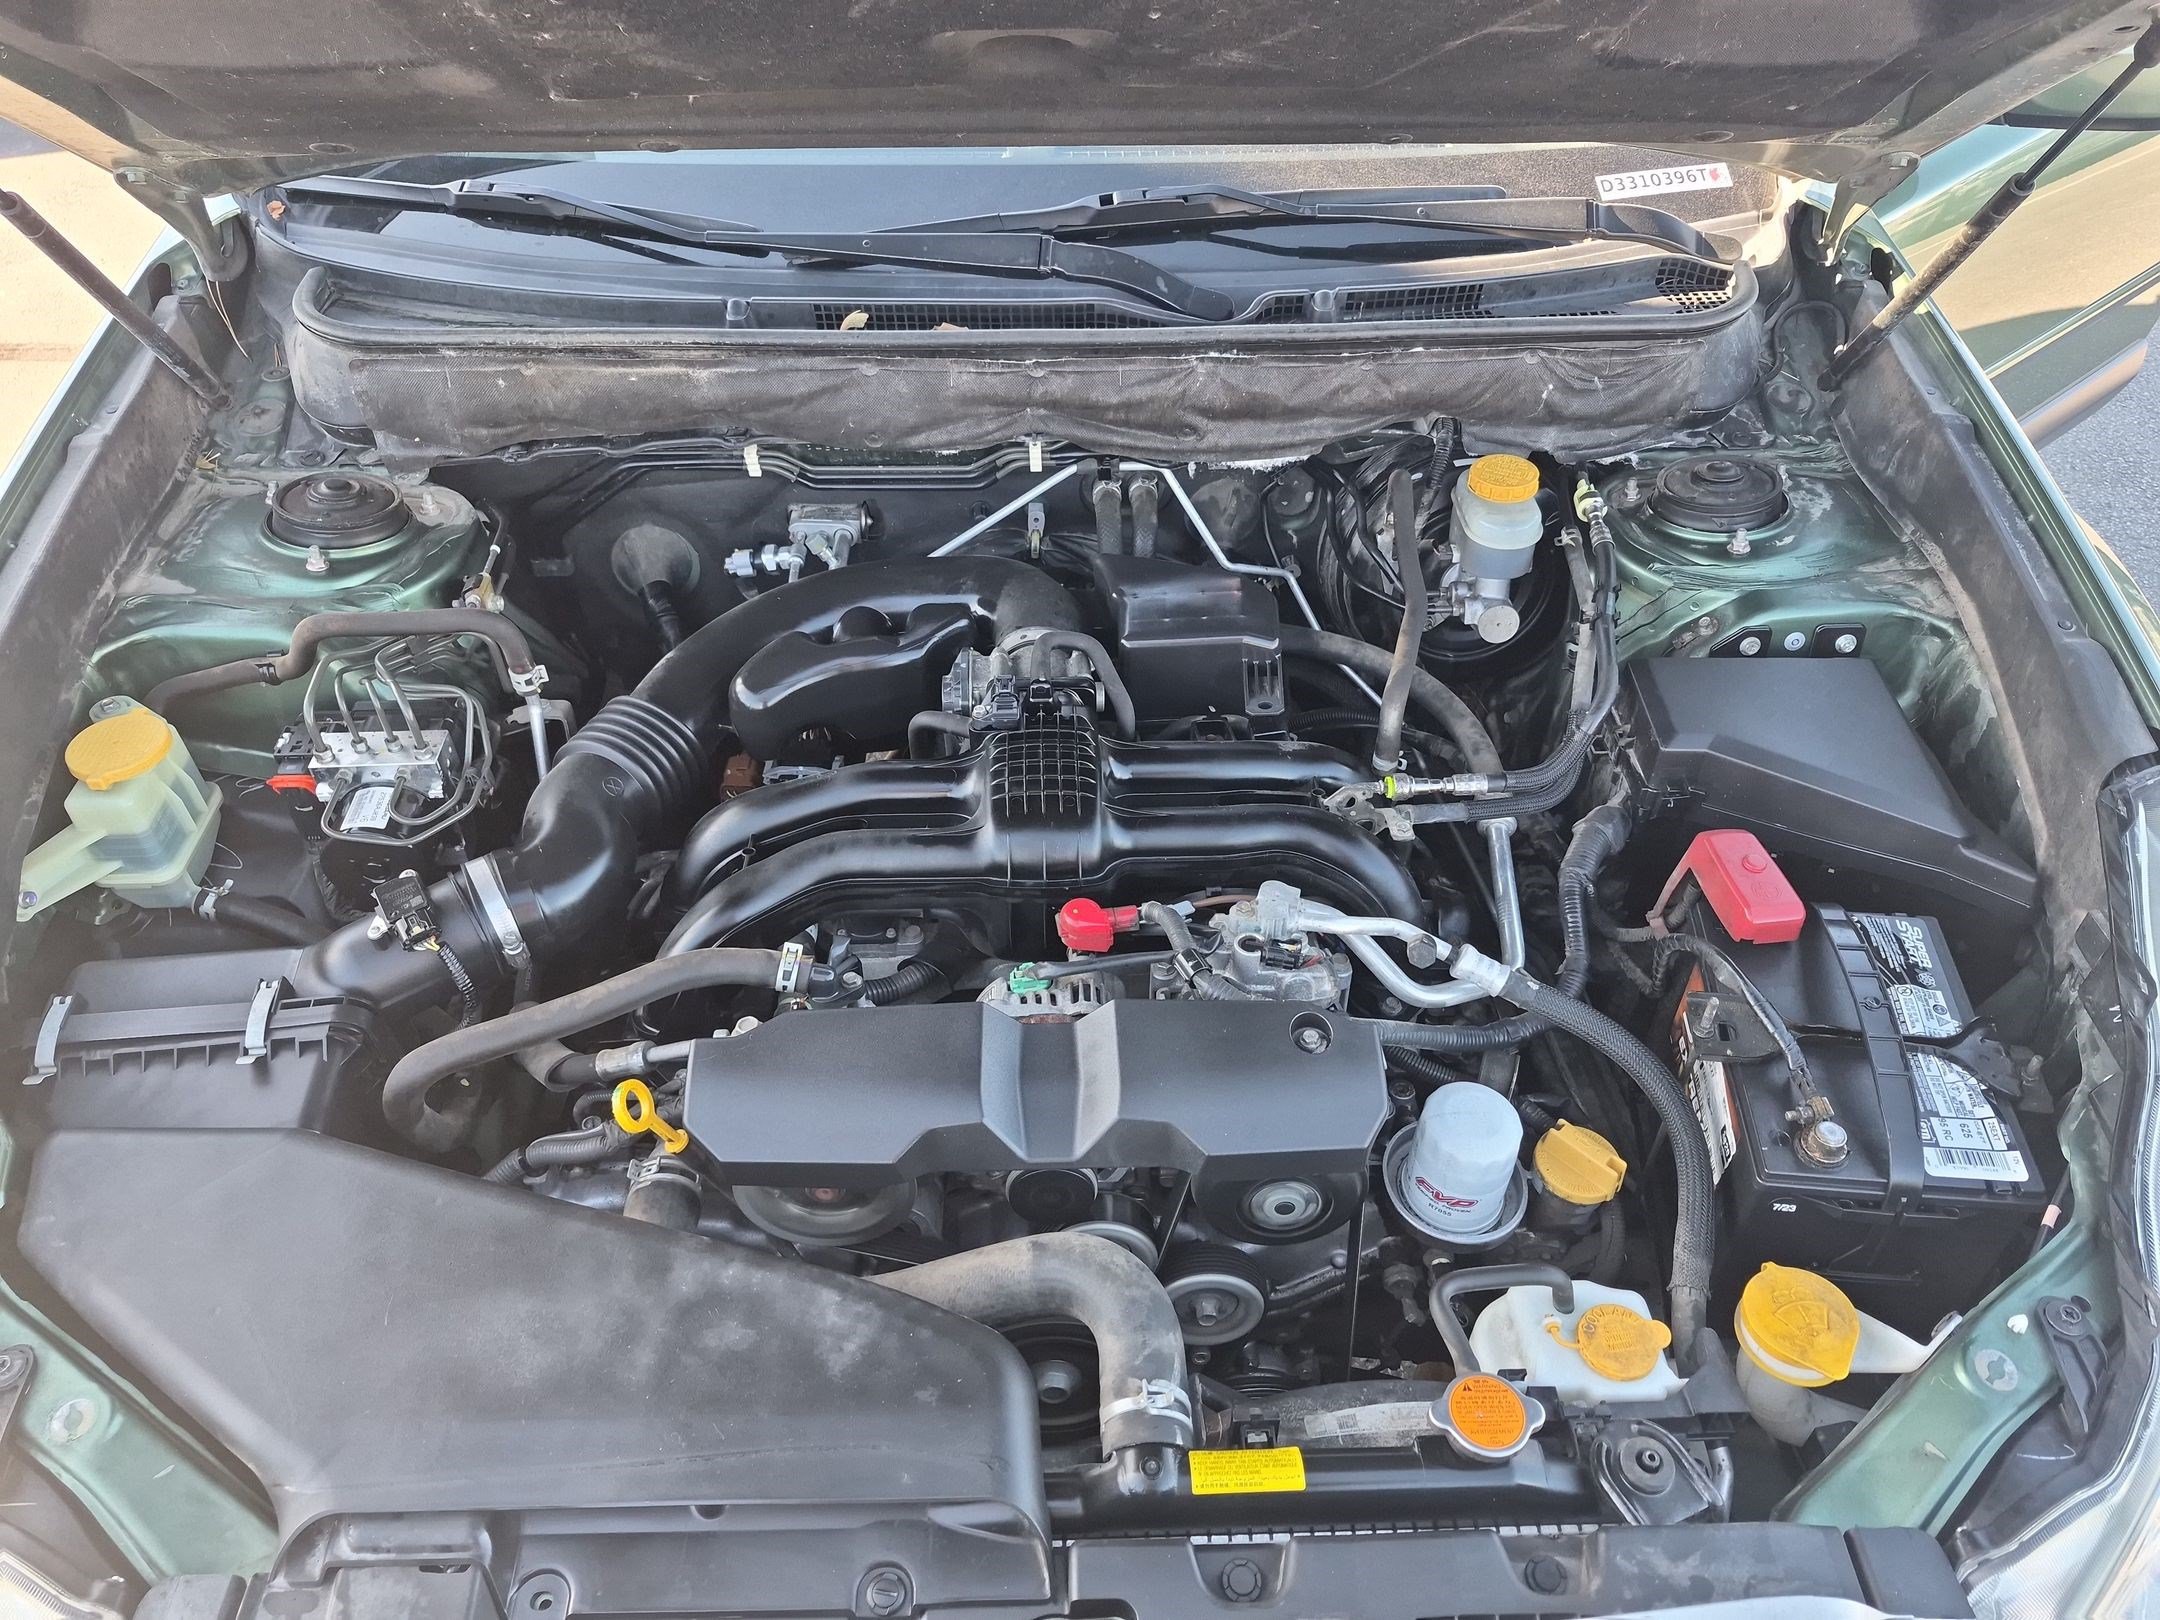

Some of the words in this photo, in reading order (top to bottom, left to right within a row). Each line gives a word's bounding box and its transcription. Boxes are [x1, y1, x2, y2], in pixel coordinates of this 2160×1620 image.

[1600, 168, 1706, 193] D3310396T
[1896, 920, 1920, 964] START
[1912, 926, 1933, 969] SUPER
[1942, 1129, 1954, 1142] RC
[1959, 1123, 1974, 1140] 625
[1428, 1202, 1452, 1217] R7055
[1773, 1203, 1797, 1212] 7/23
